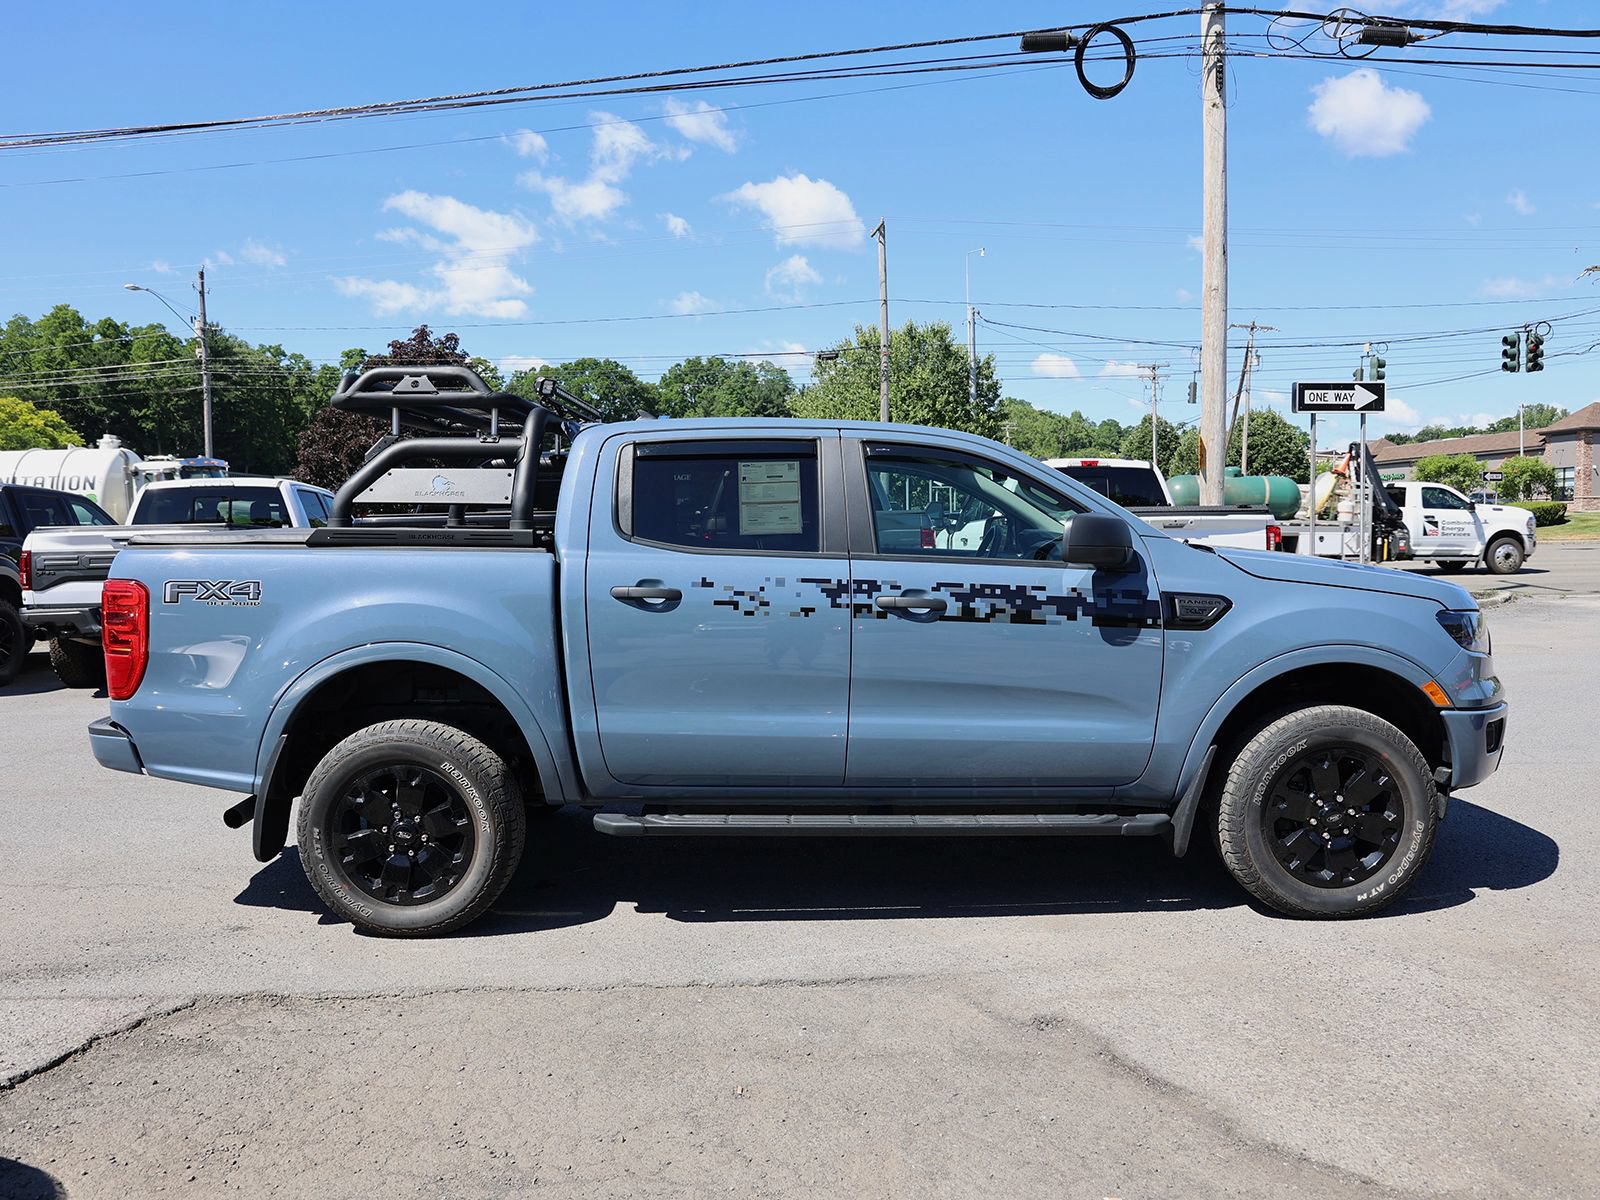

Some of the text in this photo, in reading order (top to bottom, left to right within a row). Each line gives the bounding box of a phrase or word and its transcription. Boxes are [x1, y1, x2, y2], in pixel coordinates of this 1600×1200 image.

[1308, 392, 1355, 402] ONE WAY
[163, 580, 261, 604] FX4
